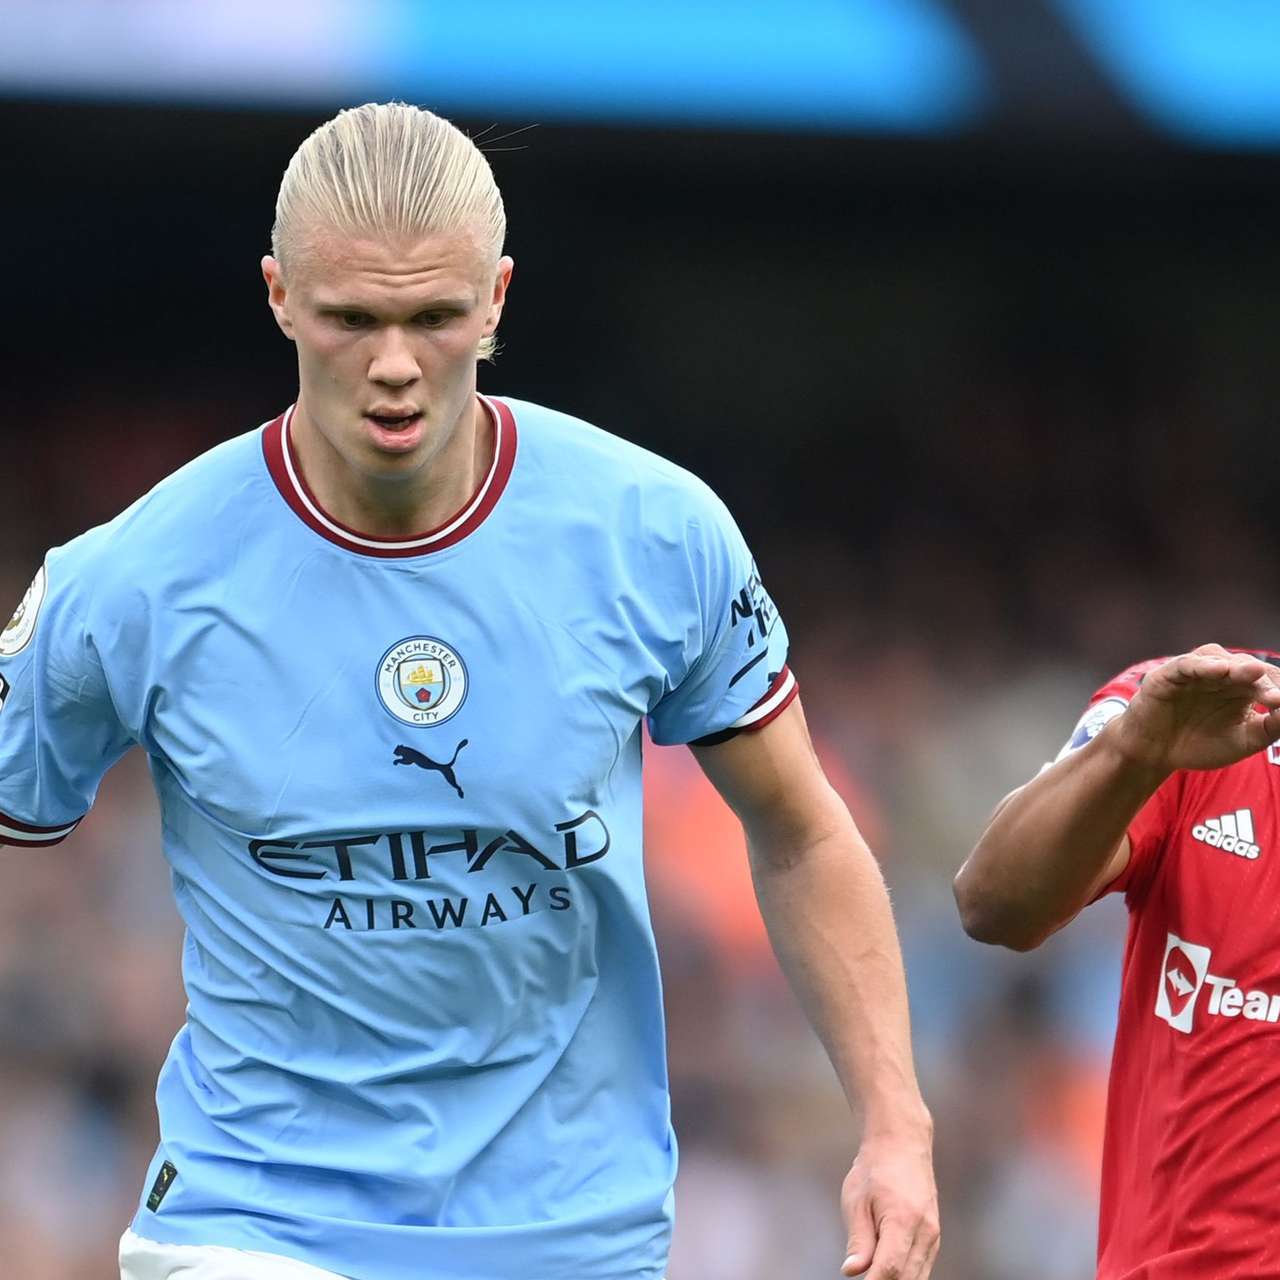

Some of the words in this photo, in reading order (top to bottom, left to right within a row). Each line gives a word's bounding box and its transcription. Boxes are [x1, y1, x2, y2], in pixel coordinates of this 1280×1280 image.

[384, 643, 457, 673] MANCHESTER
[413, 711, 439, 722] CITY
[248, 809, 610, 881] ETIHAD
[1191, 824, 1261, 860] adidas
[323, 883, 571, 929] AIRWAYS
